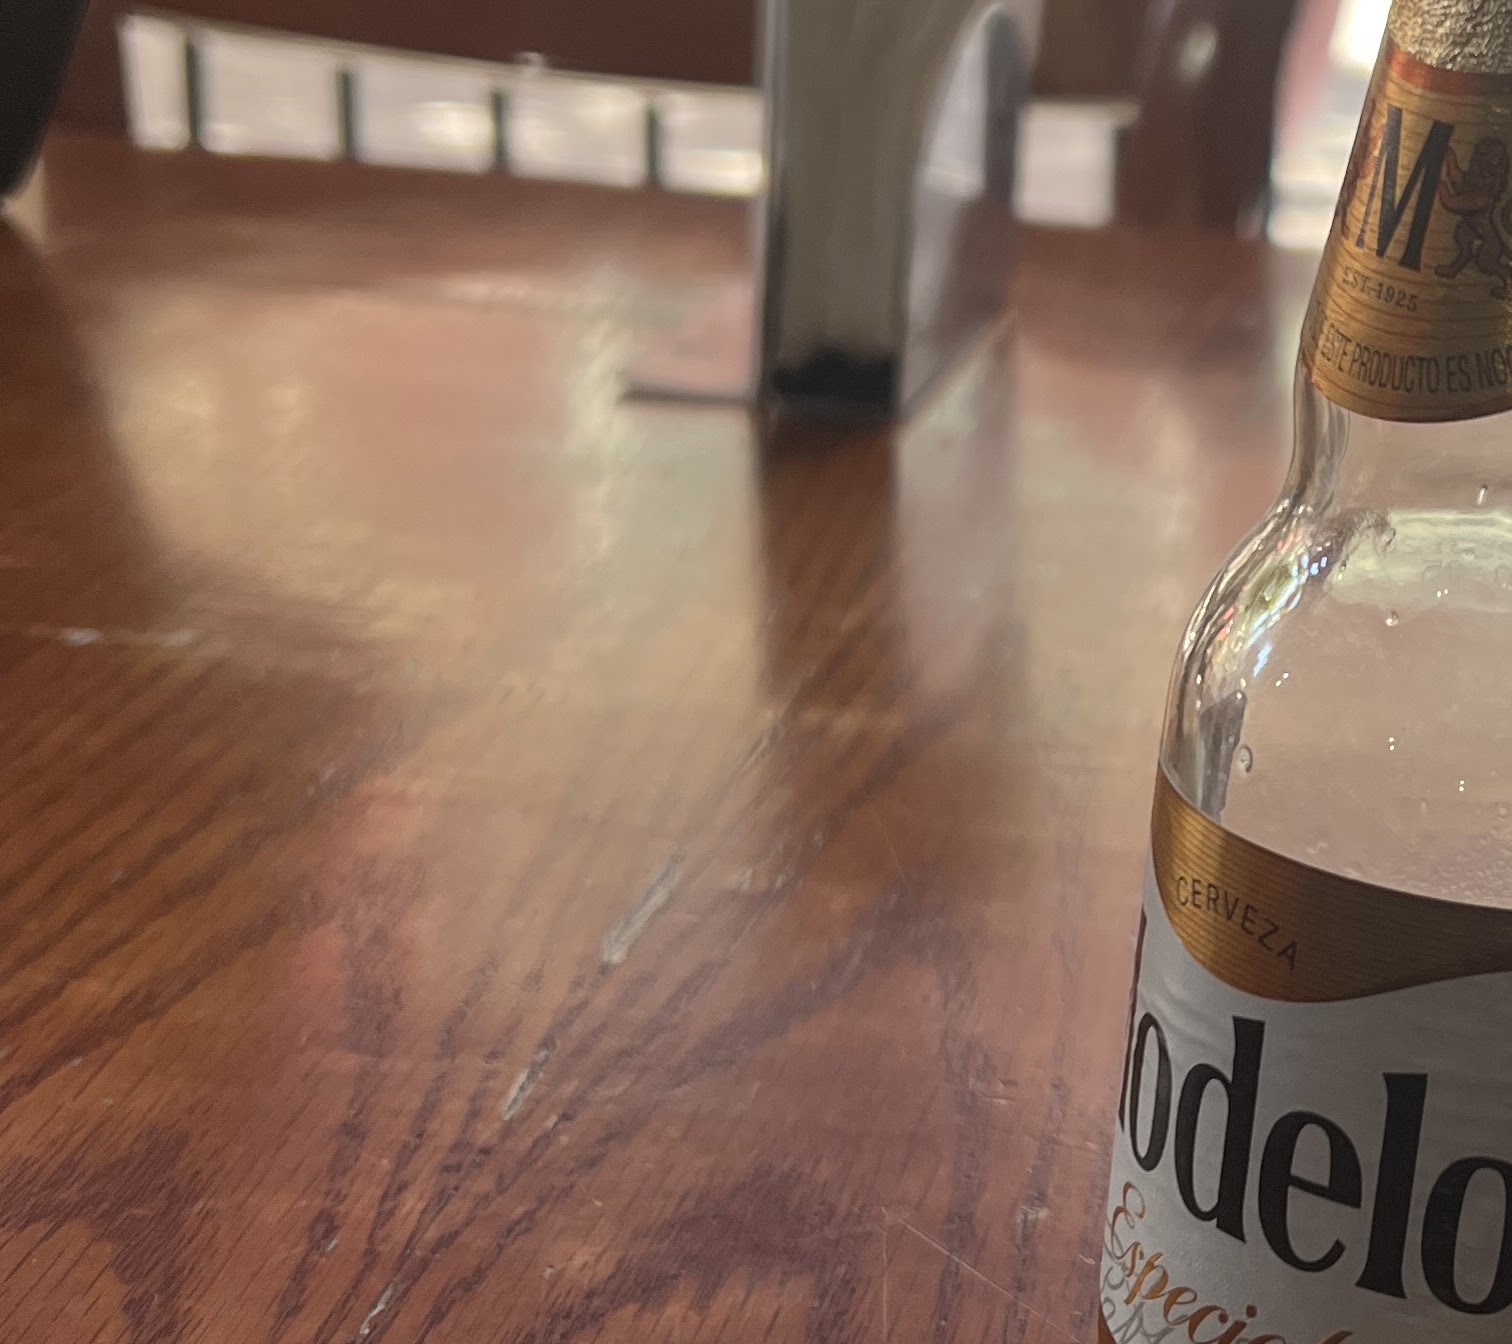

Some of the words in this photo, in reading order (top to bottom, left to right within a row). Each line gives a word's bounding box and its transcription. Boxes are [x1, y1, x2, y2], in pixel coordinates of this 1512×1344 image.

[1356, 106, 1452, 270] M
[1350, 342, 1440, 394] PRODUCTO
[1446, 355, 1472, 393] ES
[1175, 875, 1299, 971] CERVEZA
